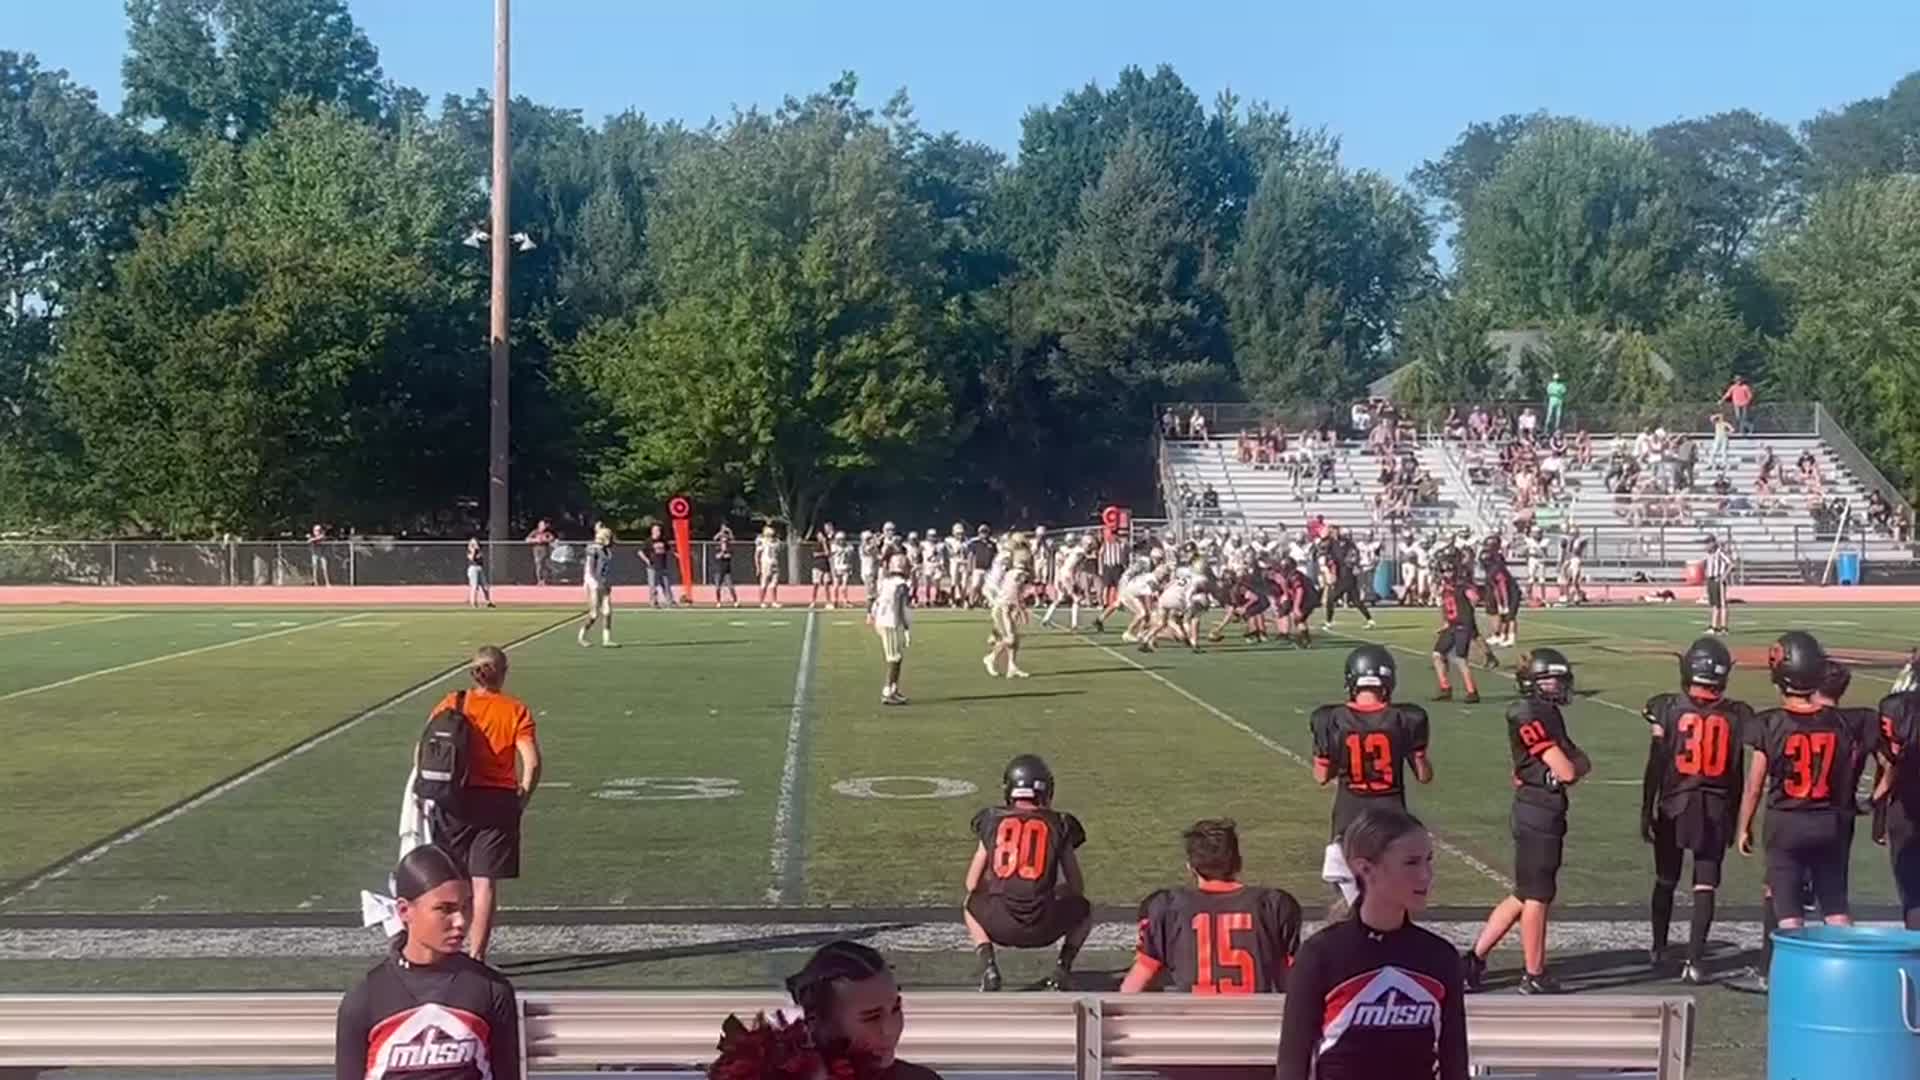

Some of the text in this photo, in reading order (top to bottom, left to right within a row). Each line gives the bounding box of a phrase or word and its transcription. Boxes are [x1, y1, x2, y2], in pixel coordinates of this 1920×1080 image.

[1345, 733, 1392, 791] 13
[1519, 719, 1547, 746] 81
[1675, 712, 1730, 777] 30
[1784, 731, 1836, 798] 37
[993, 817, 1049, 881] 80
[1191, 912, 1256, 994] 15
[1353, 990, 1435, 1026] mhsn
[389, 1027, 476, 1068] mhsn
